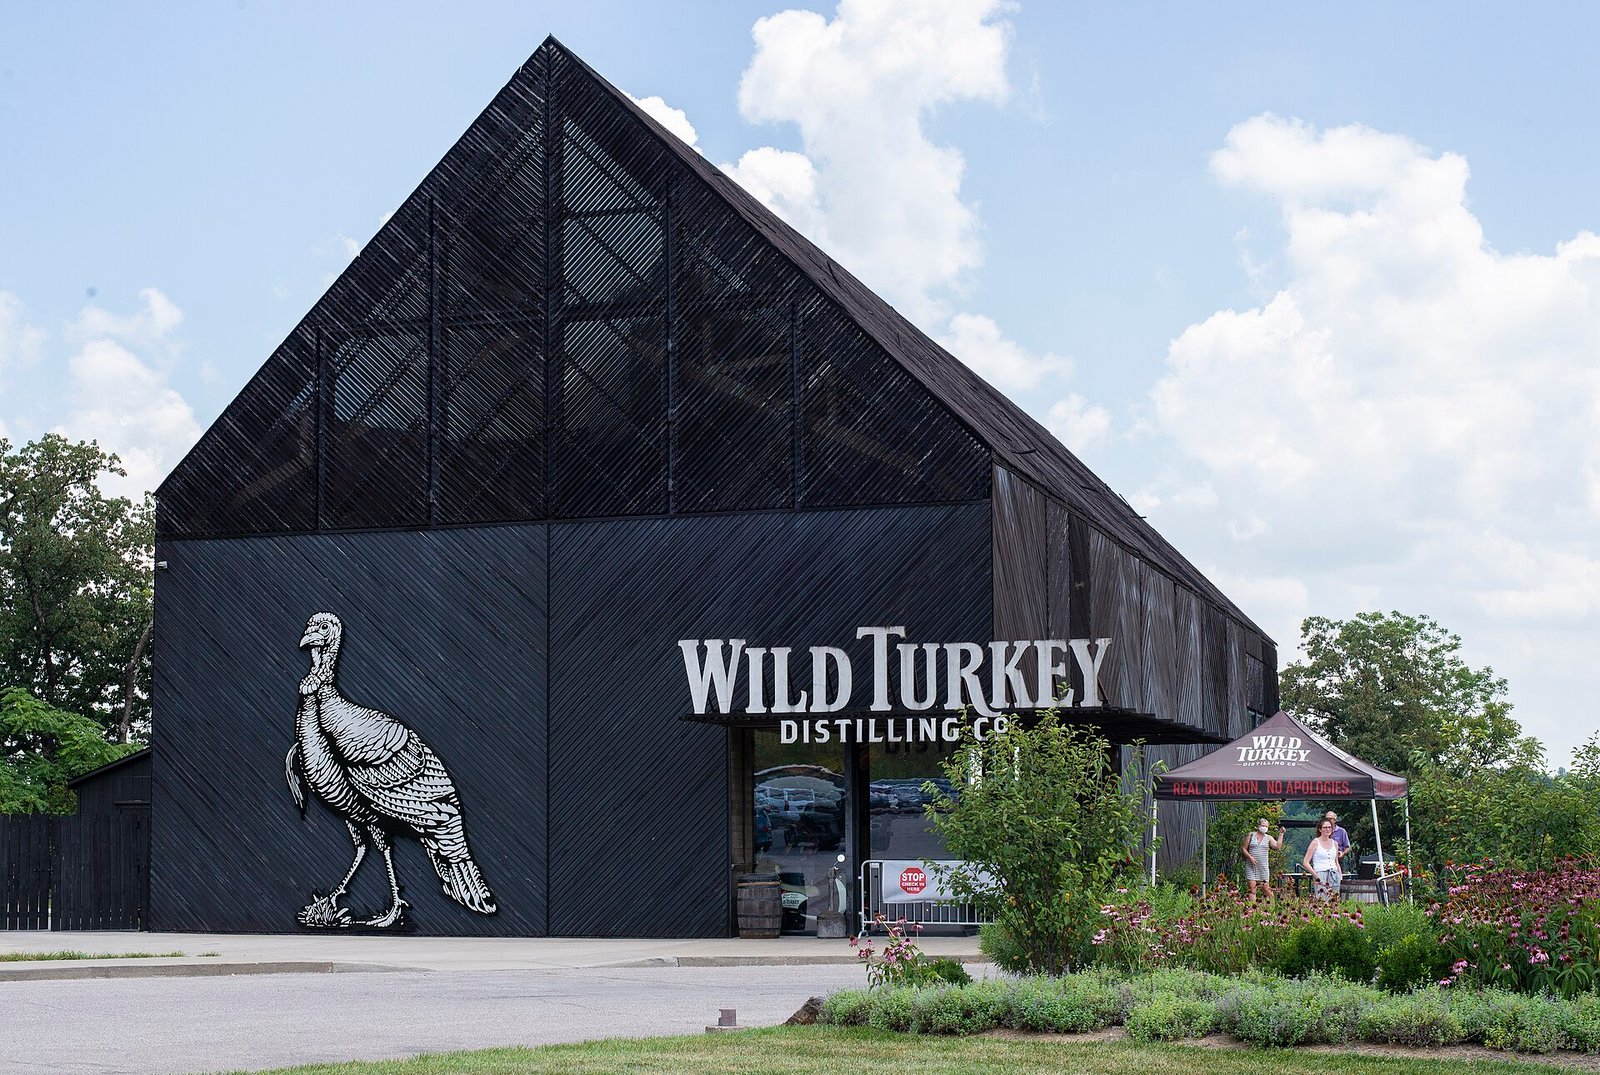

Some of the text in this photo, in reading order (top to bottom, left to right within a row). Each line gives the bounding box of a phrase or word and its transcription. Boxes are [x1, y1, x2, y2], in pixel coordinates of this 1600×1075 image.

[678, 625, 1112, 718] WILD TURKEY
[780, 717, 959, 744] DISTILLING
[1252, 735, 1302, 749] WILD
[1237, 747, 1311, 761] TURKEY
[1173, 780, 1353, 796] REAL BOURBON. NO APOLOGIES.
[901, 872, 925, 882] STOP
